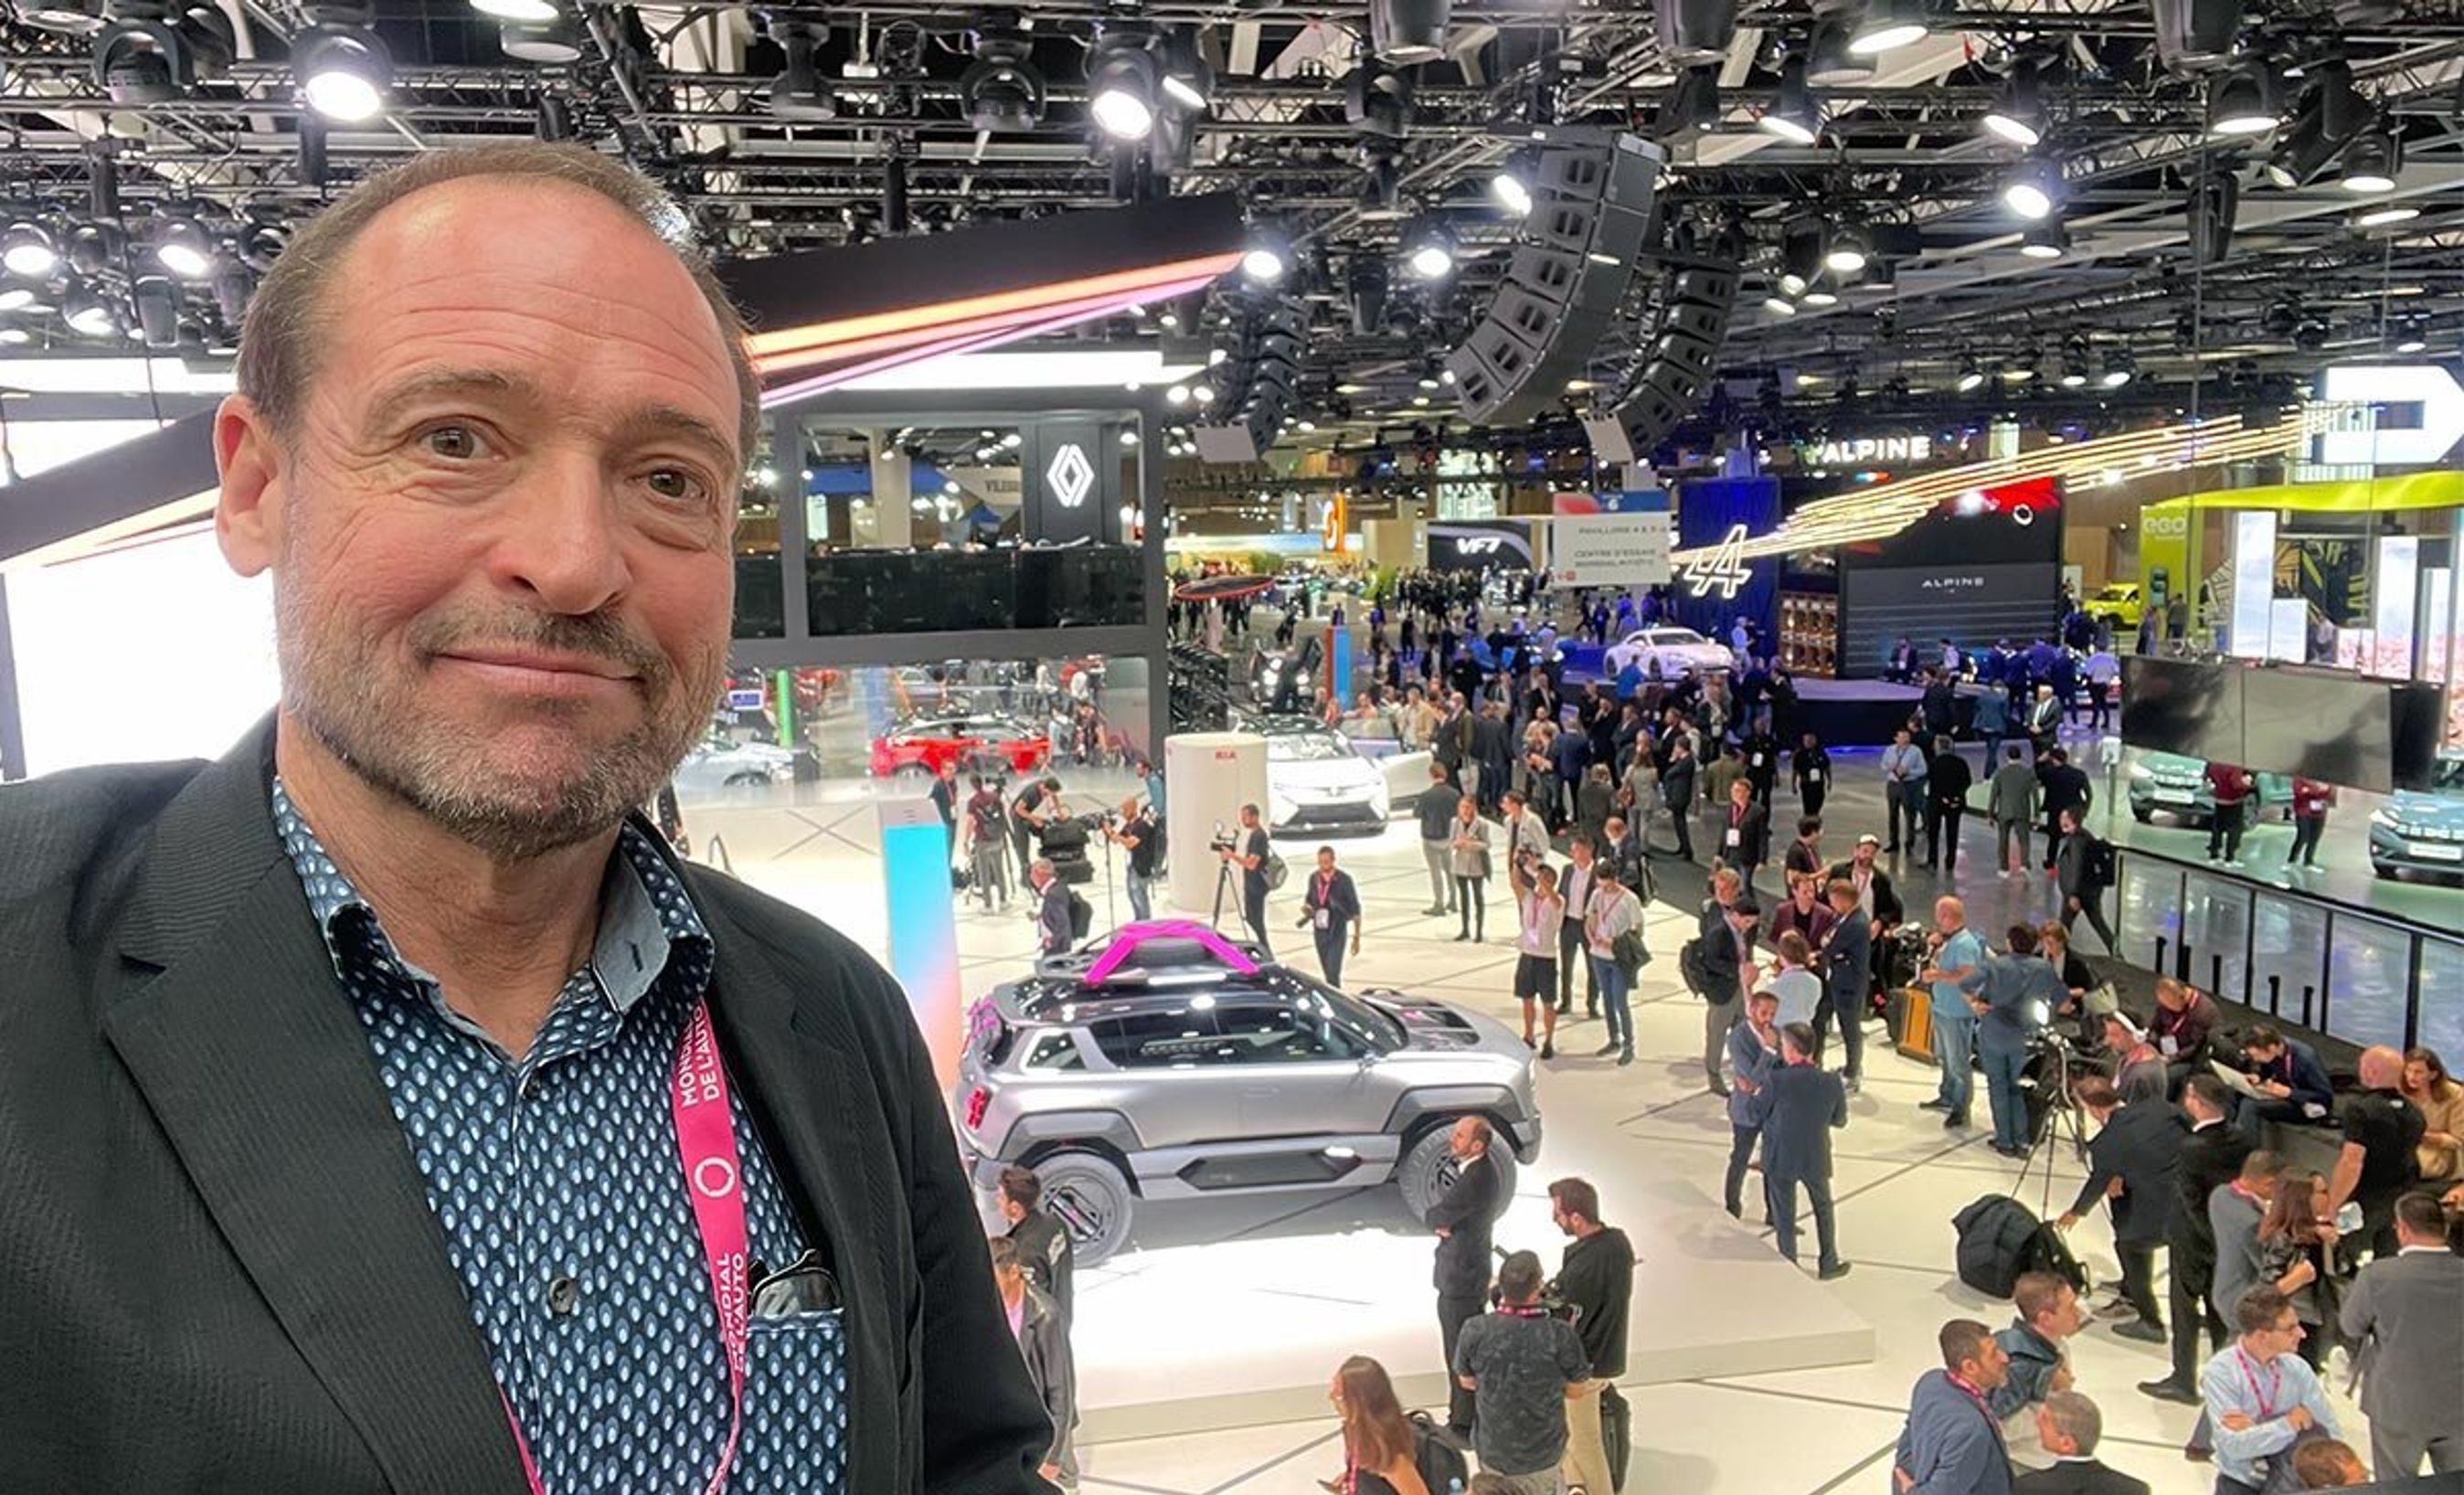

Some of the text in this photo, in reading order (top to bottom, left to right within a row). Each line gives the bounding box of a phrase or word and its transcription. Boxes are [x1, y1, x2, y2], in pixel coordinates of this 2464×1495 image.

[1821, 435, 1931, 463] ALPINE
[1921, 577, 1984, 588] ALPINE
[694, 1006, 720, 1101] DE L'AUTO
[732, 1252, 744, 1337] L'AUTO
